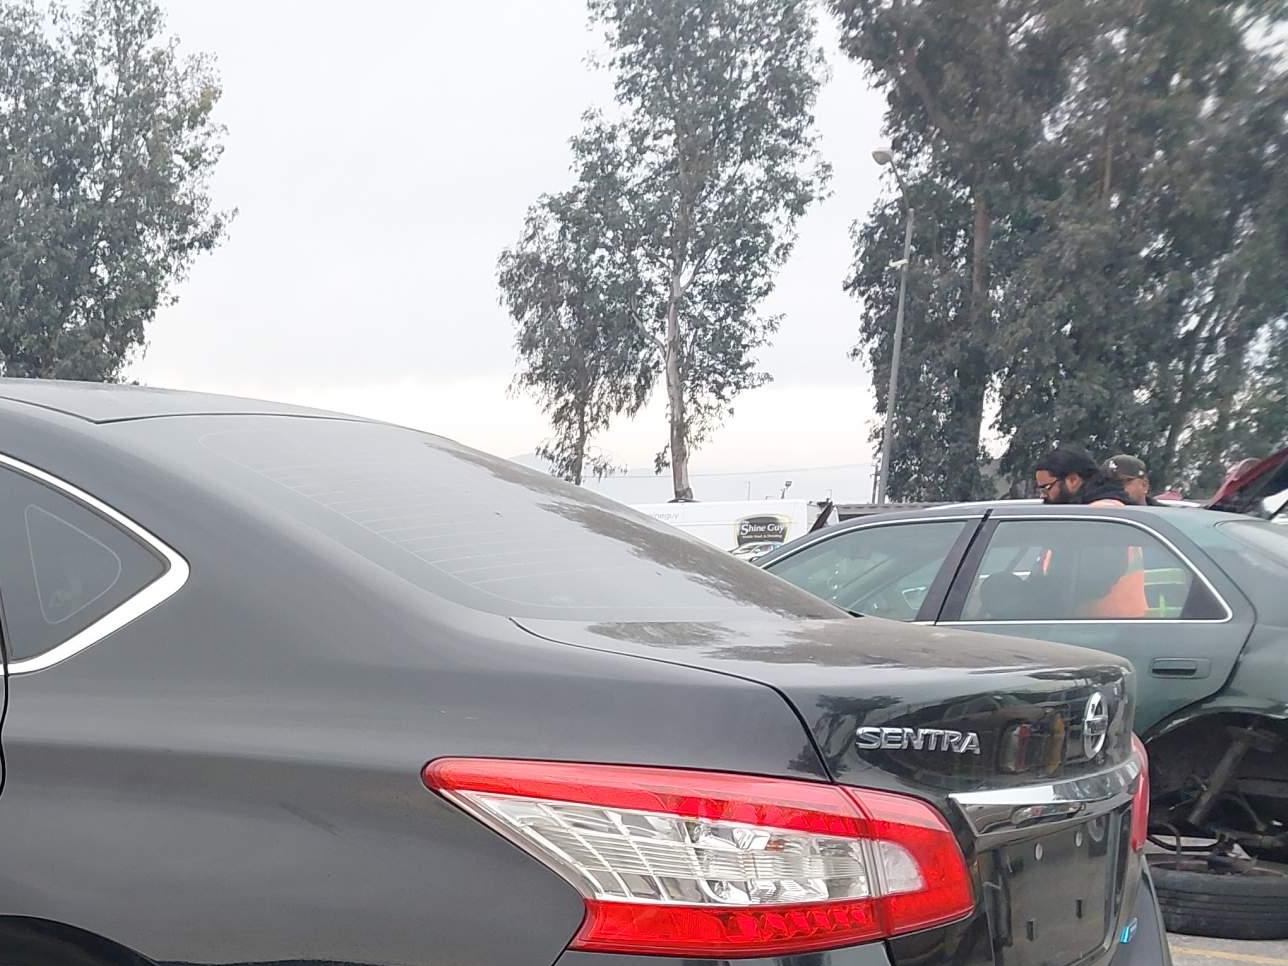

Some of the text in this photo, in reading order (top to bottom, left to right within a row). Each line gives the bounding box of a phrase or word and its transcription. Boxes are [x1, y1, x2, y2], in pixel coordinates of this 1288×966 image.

[741, 523, 766, 536] Shine
[767, 523, 785, 534] Guy
[855, 726, 981, 755] SENTRA
